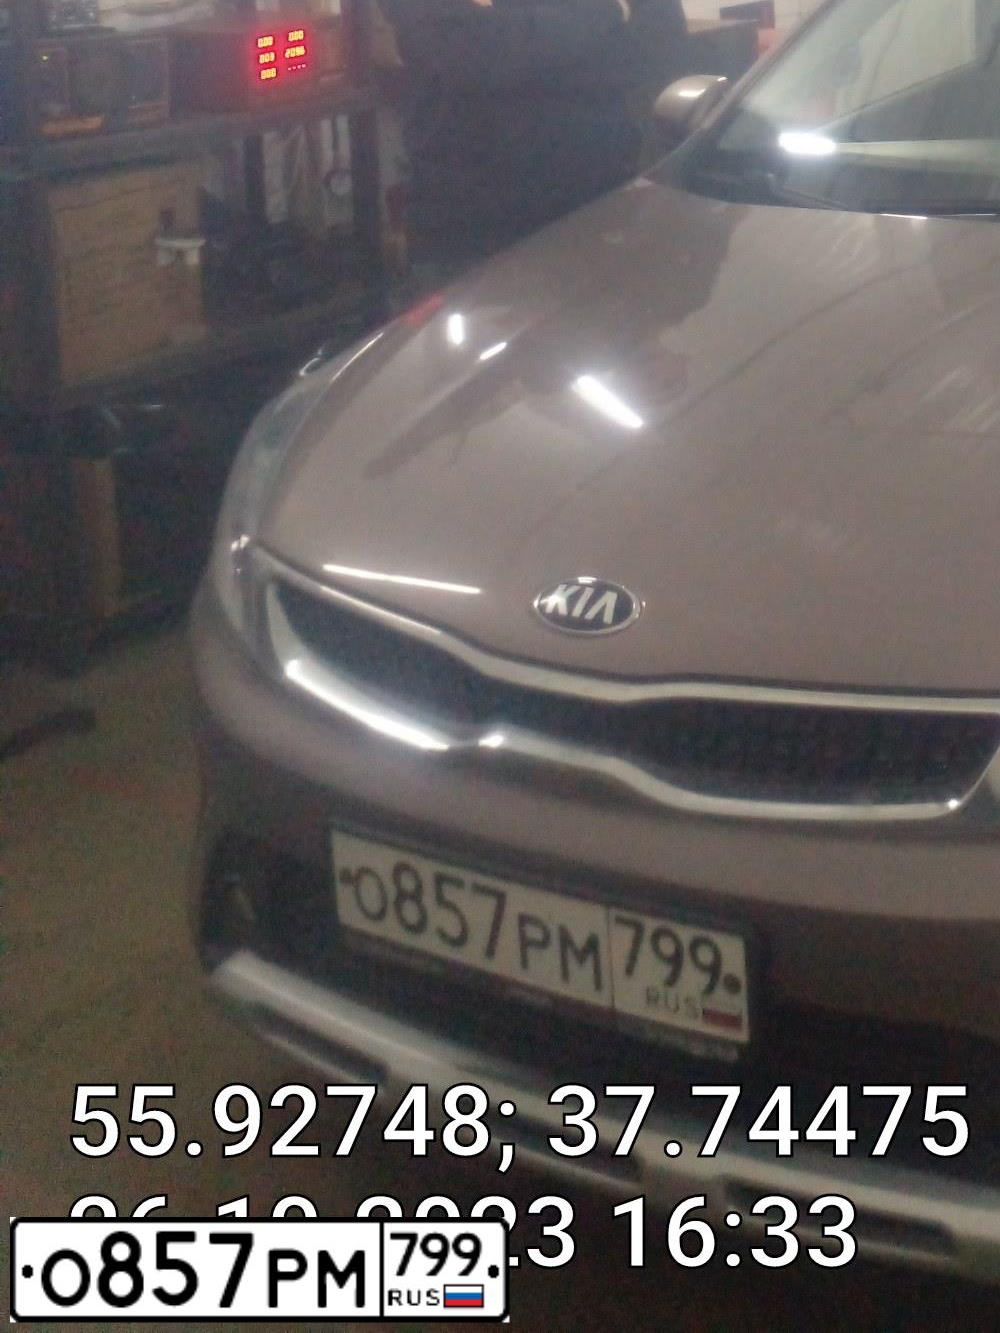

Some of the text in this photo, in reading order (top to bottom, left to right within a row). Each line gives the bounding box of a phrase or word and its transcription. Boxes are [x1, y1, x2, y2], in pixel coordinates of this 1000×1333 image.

[544, 584, 618, 625] KIA
[615, 916, 722, 996] 799
[645, 986, 700, 1020] RUS
